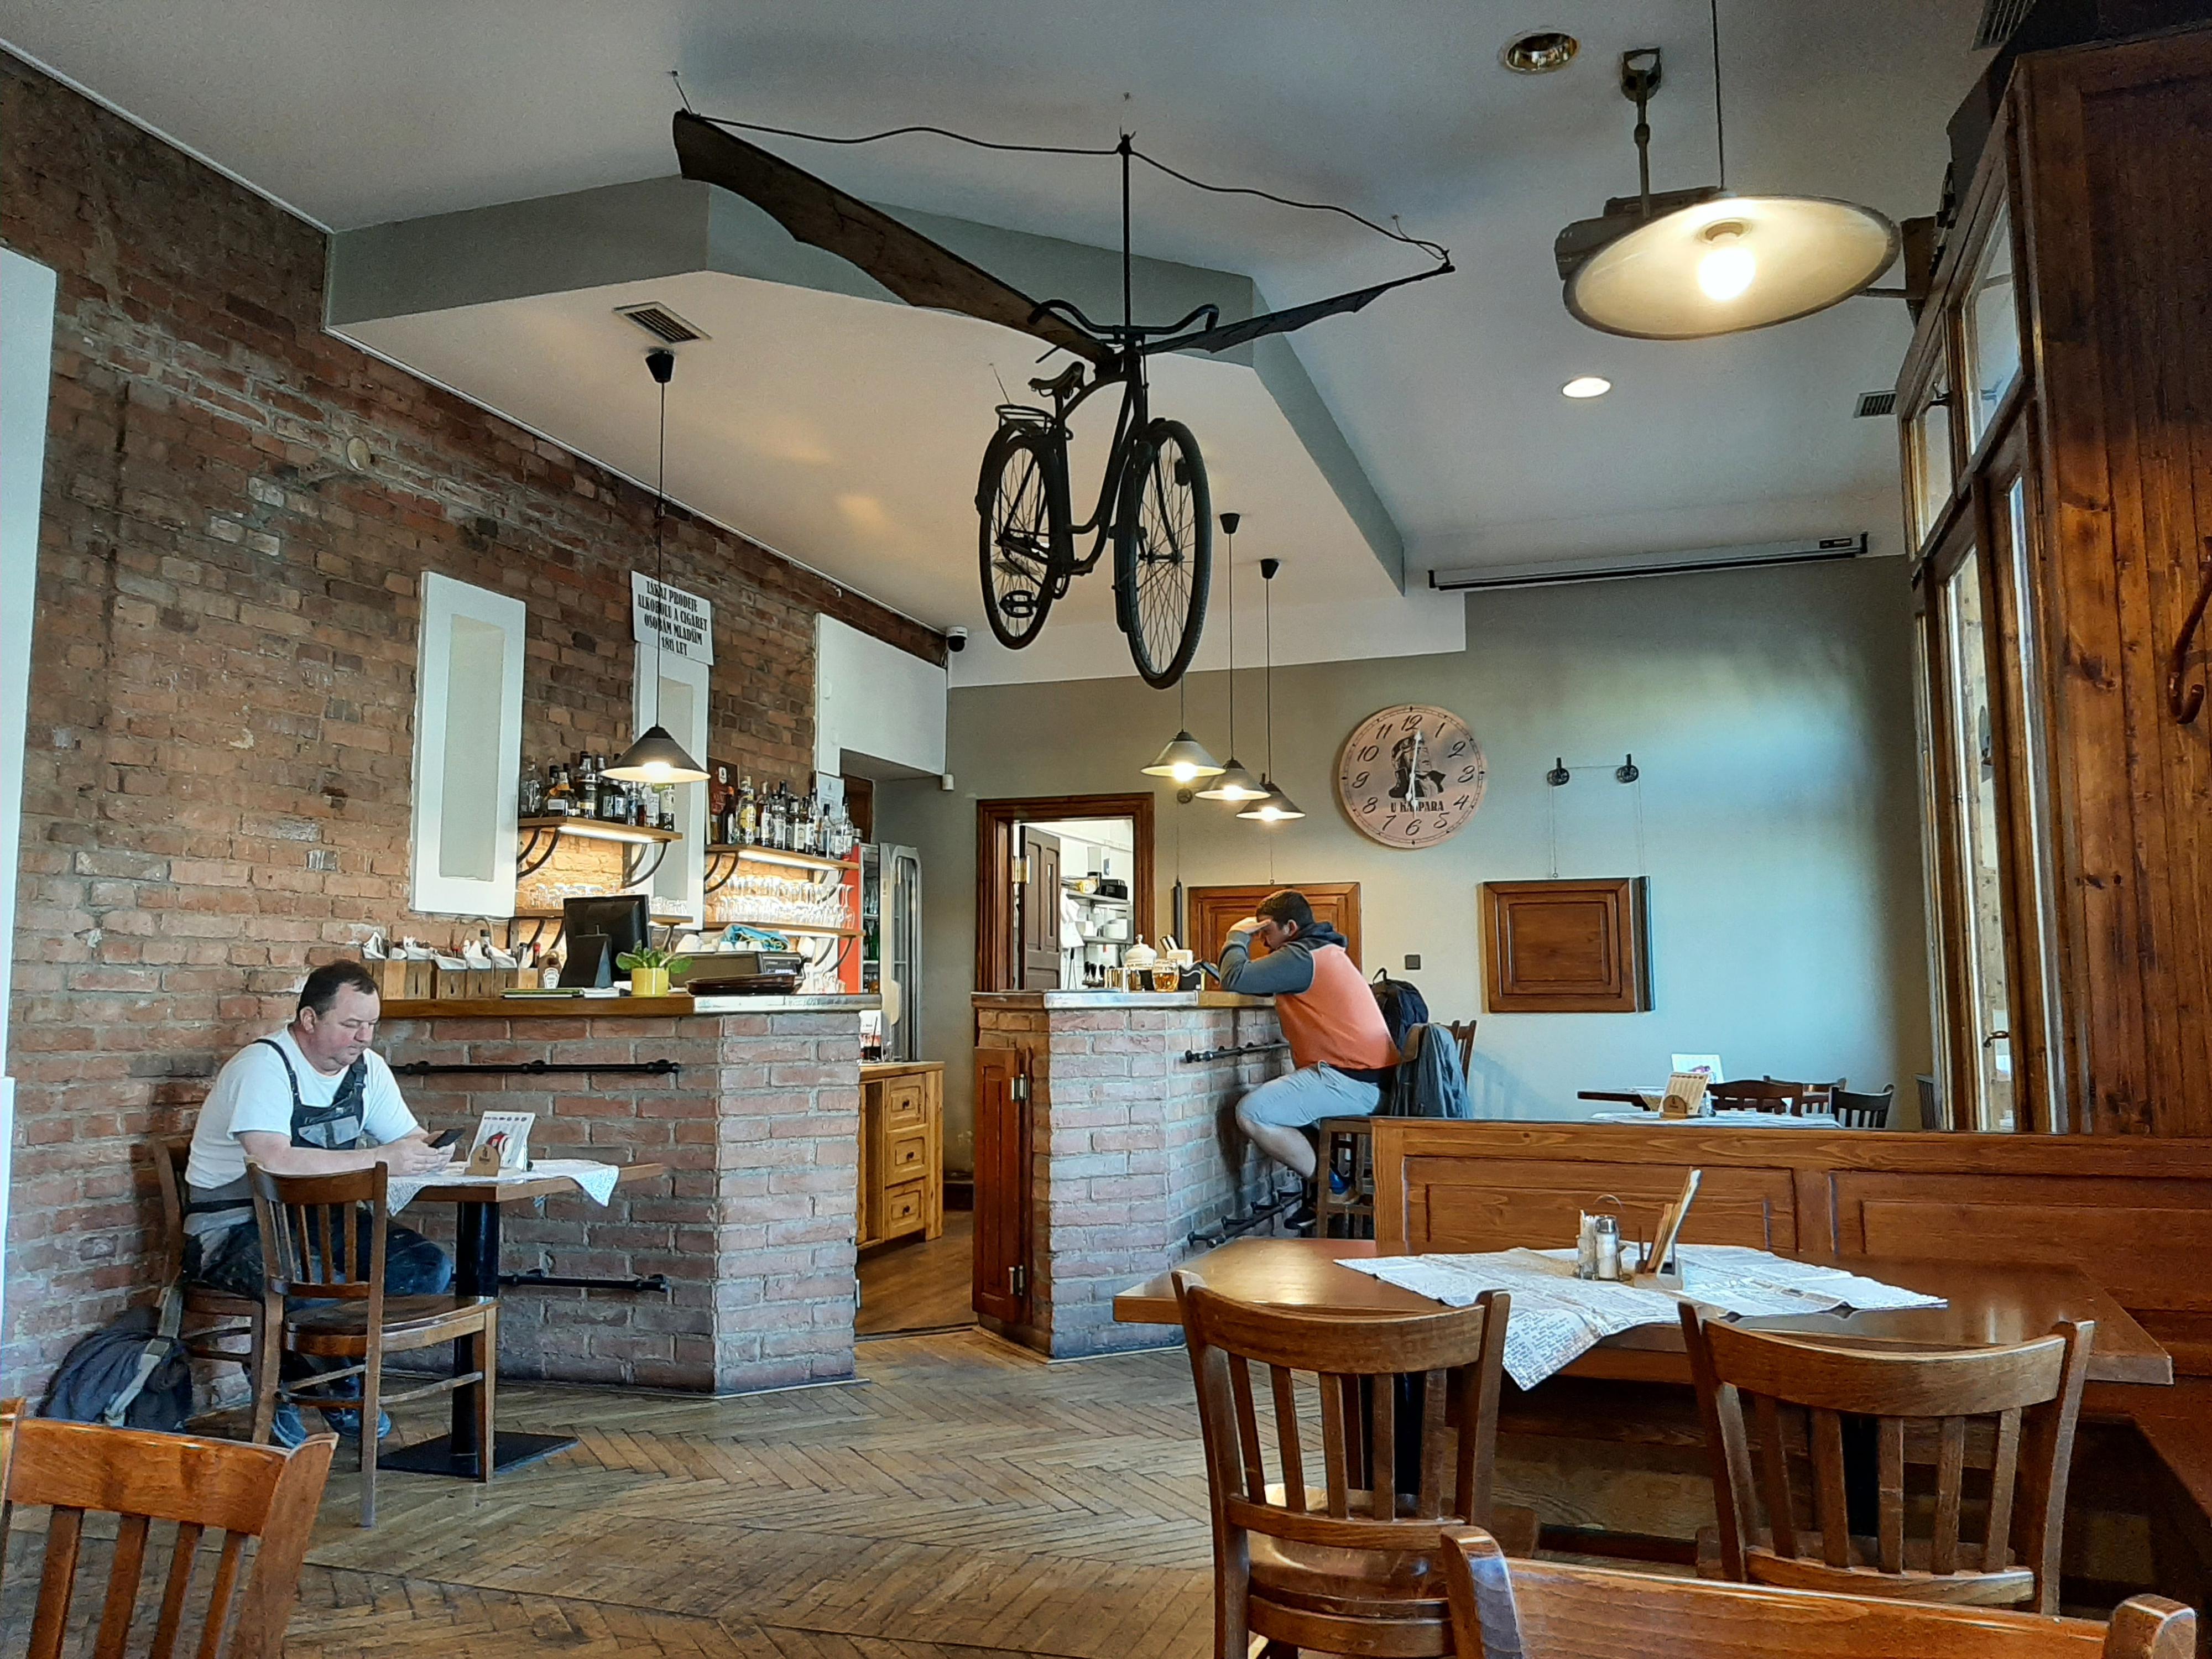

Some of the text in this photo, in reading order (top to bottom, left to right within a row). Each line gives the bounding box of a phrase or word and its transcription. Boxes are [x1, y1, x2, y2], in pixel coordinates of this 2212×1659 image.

[669, 589, 698, 612] PRODEJE
[637, 594, 707, 632] ALKOHOLU A CIGARET
[676, 640, 688, 656] LET
[1401, 714, 1423, 731] 12
[1434, 722, 1446, 738] 1
[1375, 723, 1393, 740] 11
[1357, 745, 1379, 761] 10
[1447, 740, 1466, 758] 2
[1352, 771, 1370, 789] 9
[1458, 765, 1475, 783] 3
[1362, 796, 1379, 814] 8
[1391, 800, 1444, 813] U KAPARA
[1453, 795, 1469, 811] 4
[1382, 814, 1396, 831] 7
[1405, 818, 1422, 836] 6
[1433, 812, 1450, 828] 5
